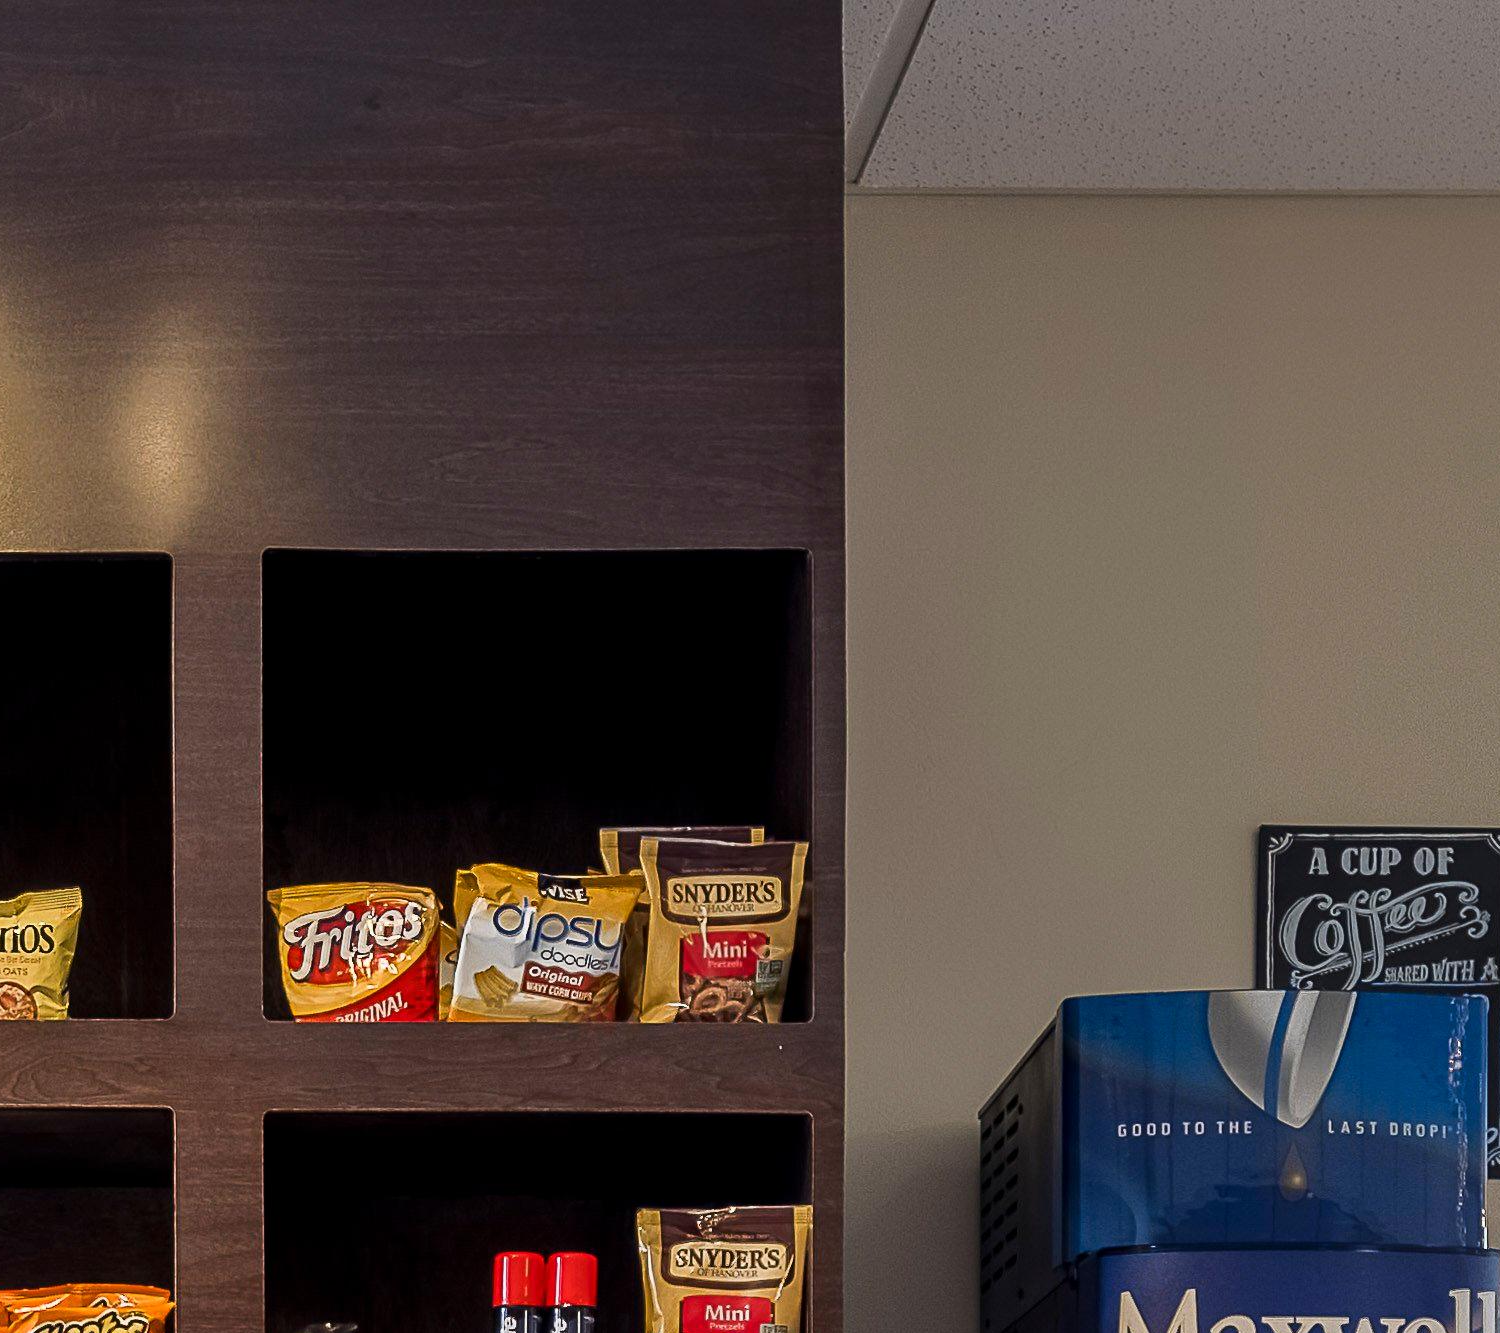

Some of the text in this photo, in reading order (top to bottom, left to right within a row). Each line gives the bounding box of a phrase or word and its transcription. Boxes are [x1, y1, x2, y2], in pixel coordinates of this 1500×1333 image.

[1308, 847, 1455, 876] A CUP OF
[673, 881, 776, 904] SNYDER'S
[284, 902, 423, 980] Fritos
[493, 897, 626, 968] dipsy
[1279, 882, 1480, 989] Coffee
[541, 947, 613, 970] doodles
[703, 940, 748, 959] Mini
[529, 966, 584, 986] Original
[1384, 957, 1499, 983] SHARED WITH A
[1117, 1121, 1172, 1138] GOOD
[1181, 1120, 1206, 1136] TO
[1216, 1120, 1253, 1135] THE
[1327, 1119, 1377, 1136] LAST
[676, 1248, 781, 1270] SNYDER'S
[711, 1270, 758, 1278] HANOVER
[705, 1305, 750, 1321] Mini
